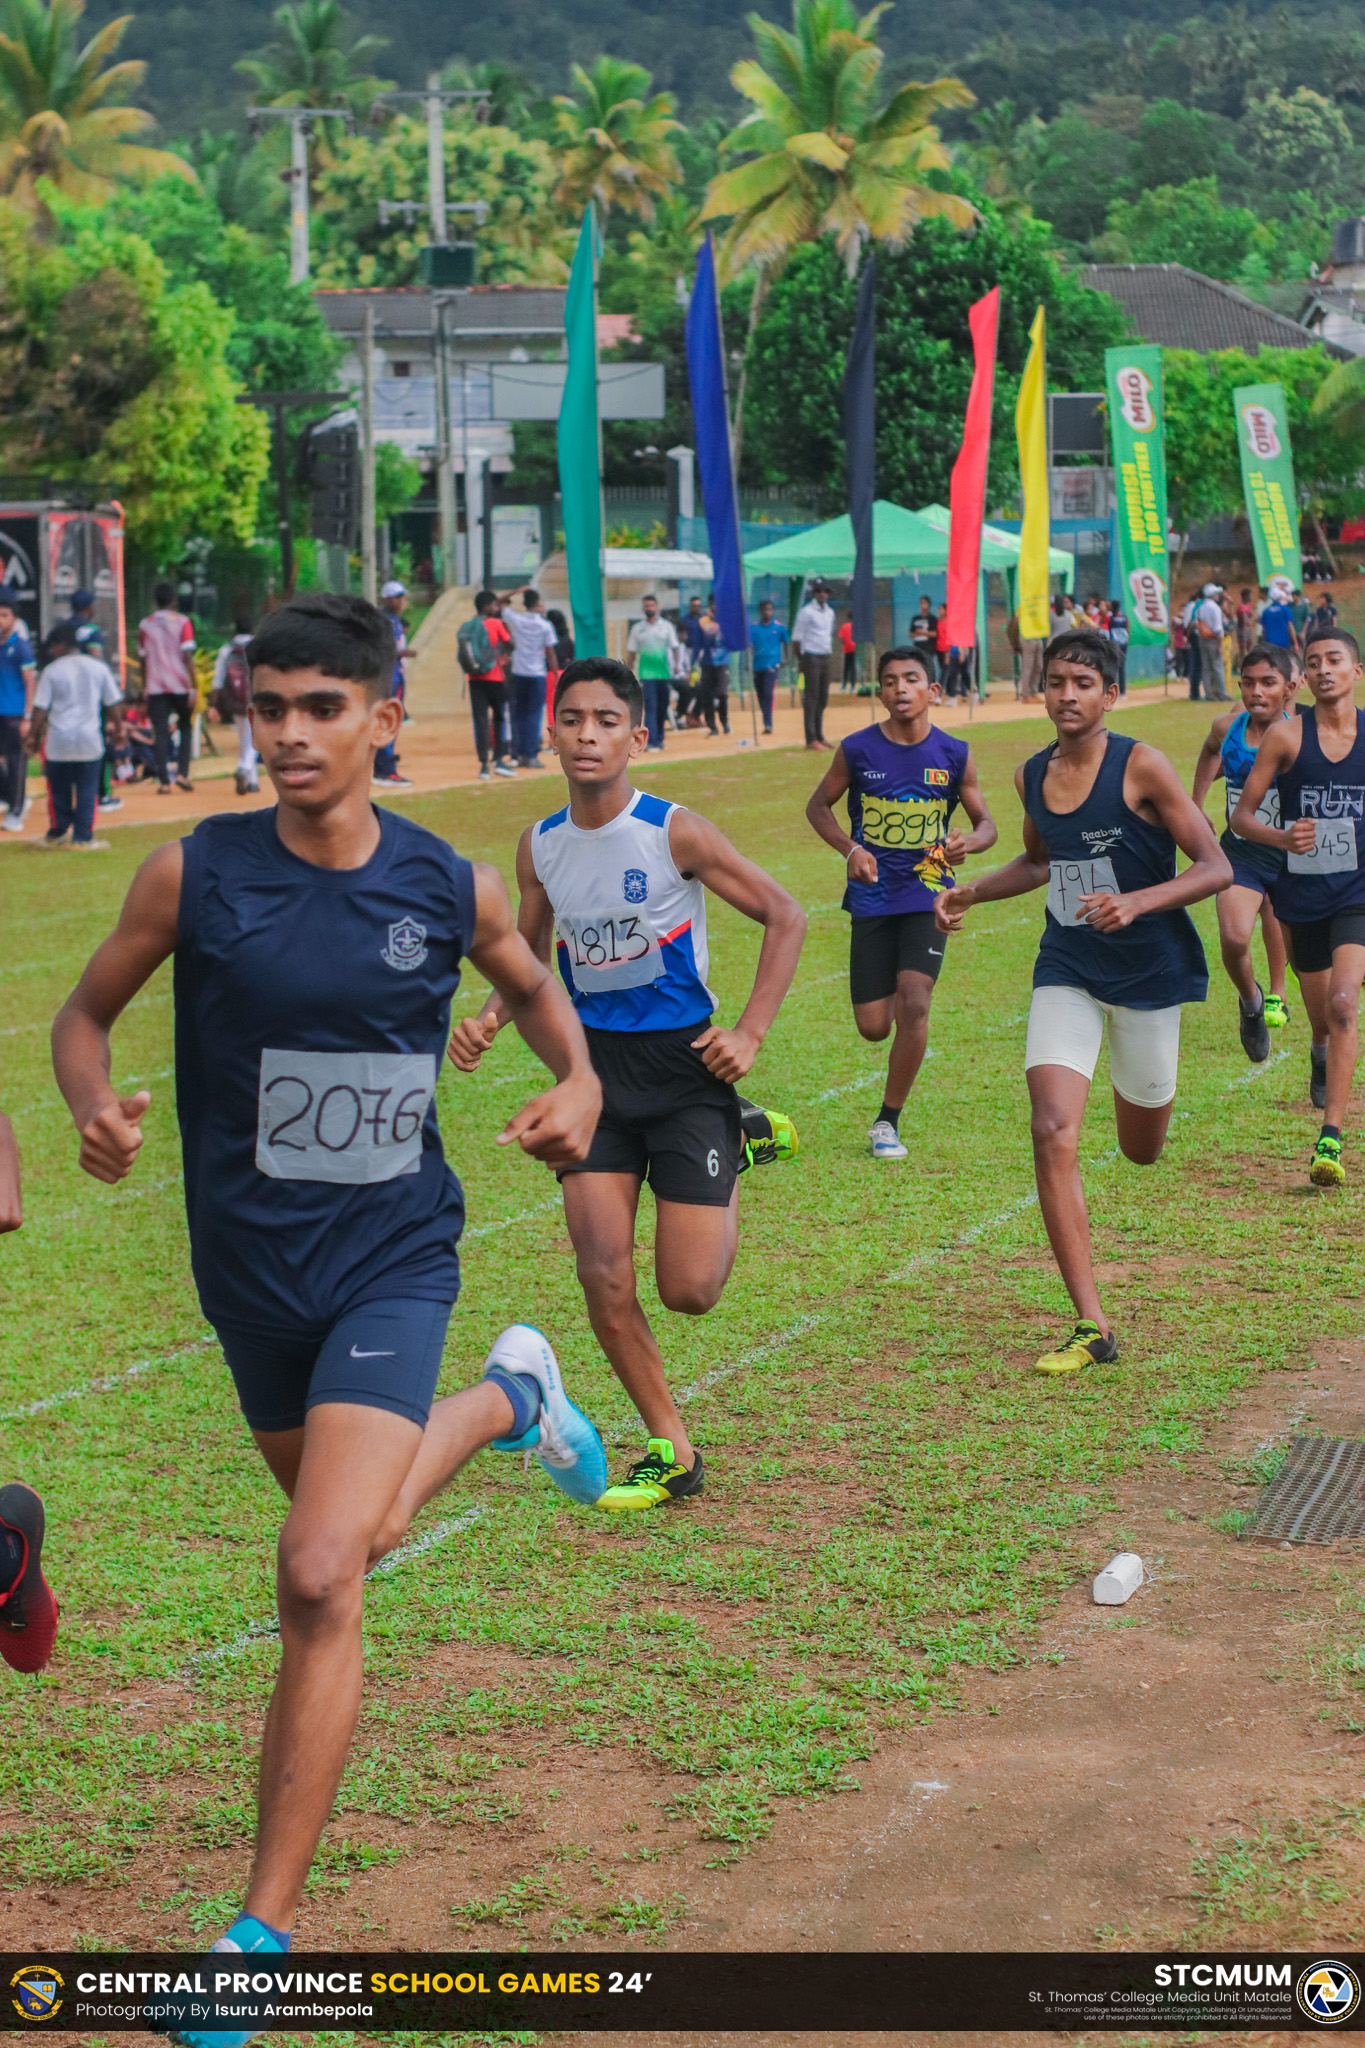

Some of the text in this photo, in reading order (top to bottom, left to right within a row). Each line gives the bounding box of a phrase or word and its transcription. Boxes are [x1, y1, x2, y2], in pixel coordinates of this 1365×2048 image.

[1128, 374, 1146, 422] MILO
[1251, 412, 1270, 453] MILO
[1121, 463, 1147, 541] NOURISH
[1134, 442, 1165, 555] TO GO FURTHER
[1248, 471, 1265, 488] TO
[1258, 510, 1285, 566] FURTHER
[1265, 482, 1295, 548] NOURISH
[1142, 576, 1163, 622] MILO
[863, 807, 941, 845] 2899
[1300, 788, 1364, 818] RUN
[1081, 827, 1123, 841] Reebok
[571, 916, 650, 967] 1813
[265, 1076, 426, 1152] 2076
[707, 1149, 719, 1177] 6
